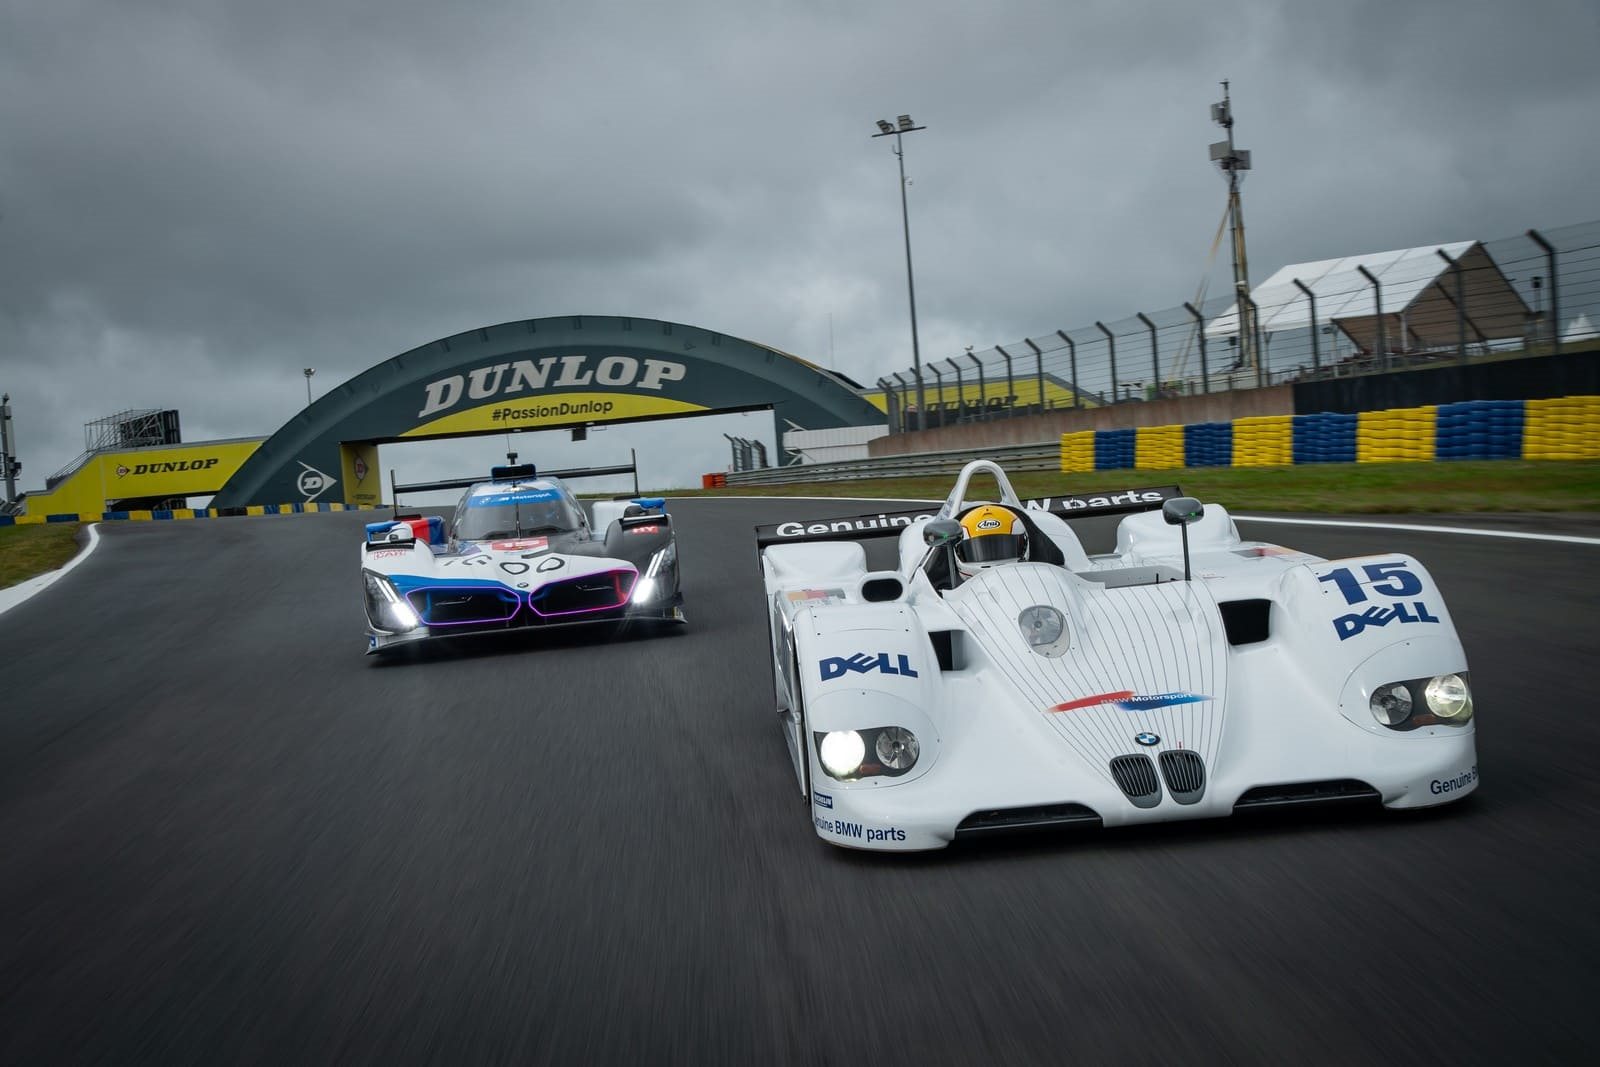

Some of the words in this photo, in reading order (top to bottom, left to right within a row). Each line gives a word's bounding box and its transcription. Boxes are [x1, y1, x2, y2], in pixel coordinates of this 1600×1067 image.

[418, 355, 687, 419] DUNLOP
[492, 400, 614, 422] #PassionDunlop
[133, 458, 219, 475] DUNLOP
[1062, 490, 1164, 510] parts
[981, 519, 999, 529] Arai
[1318, 561, 1423, 605] 15
[1333, 602, 1440, 641] DELL
[819, 653, 919, 682] DELL
[1131, 692, 1193, 703] Motorsport
[1430, 772, 1472, 795] Genuine
[835, 820, 863, 838] BMW
[866, 827, 906, 843] parts
